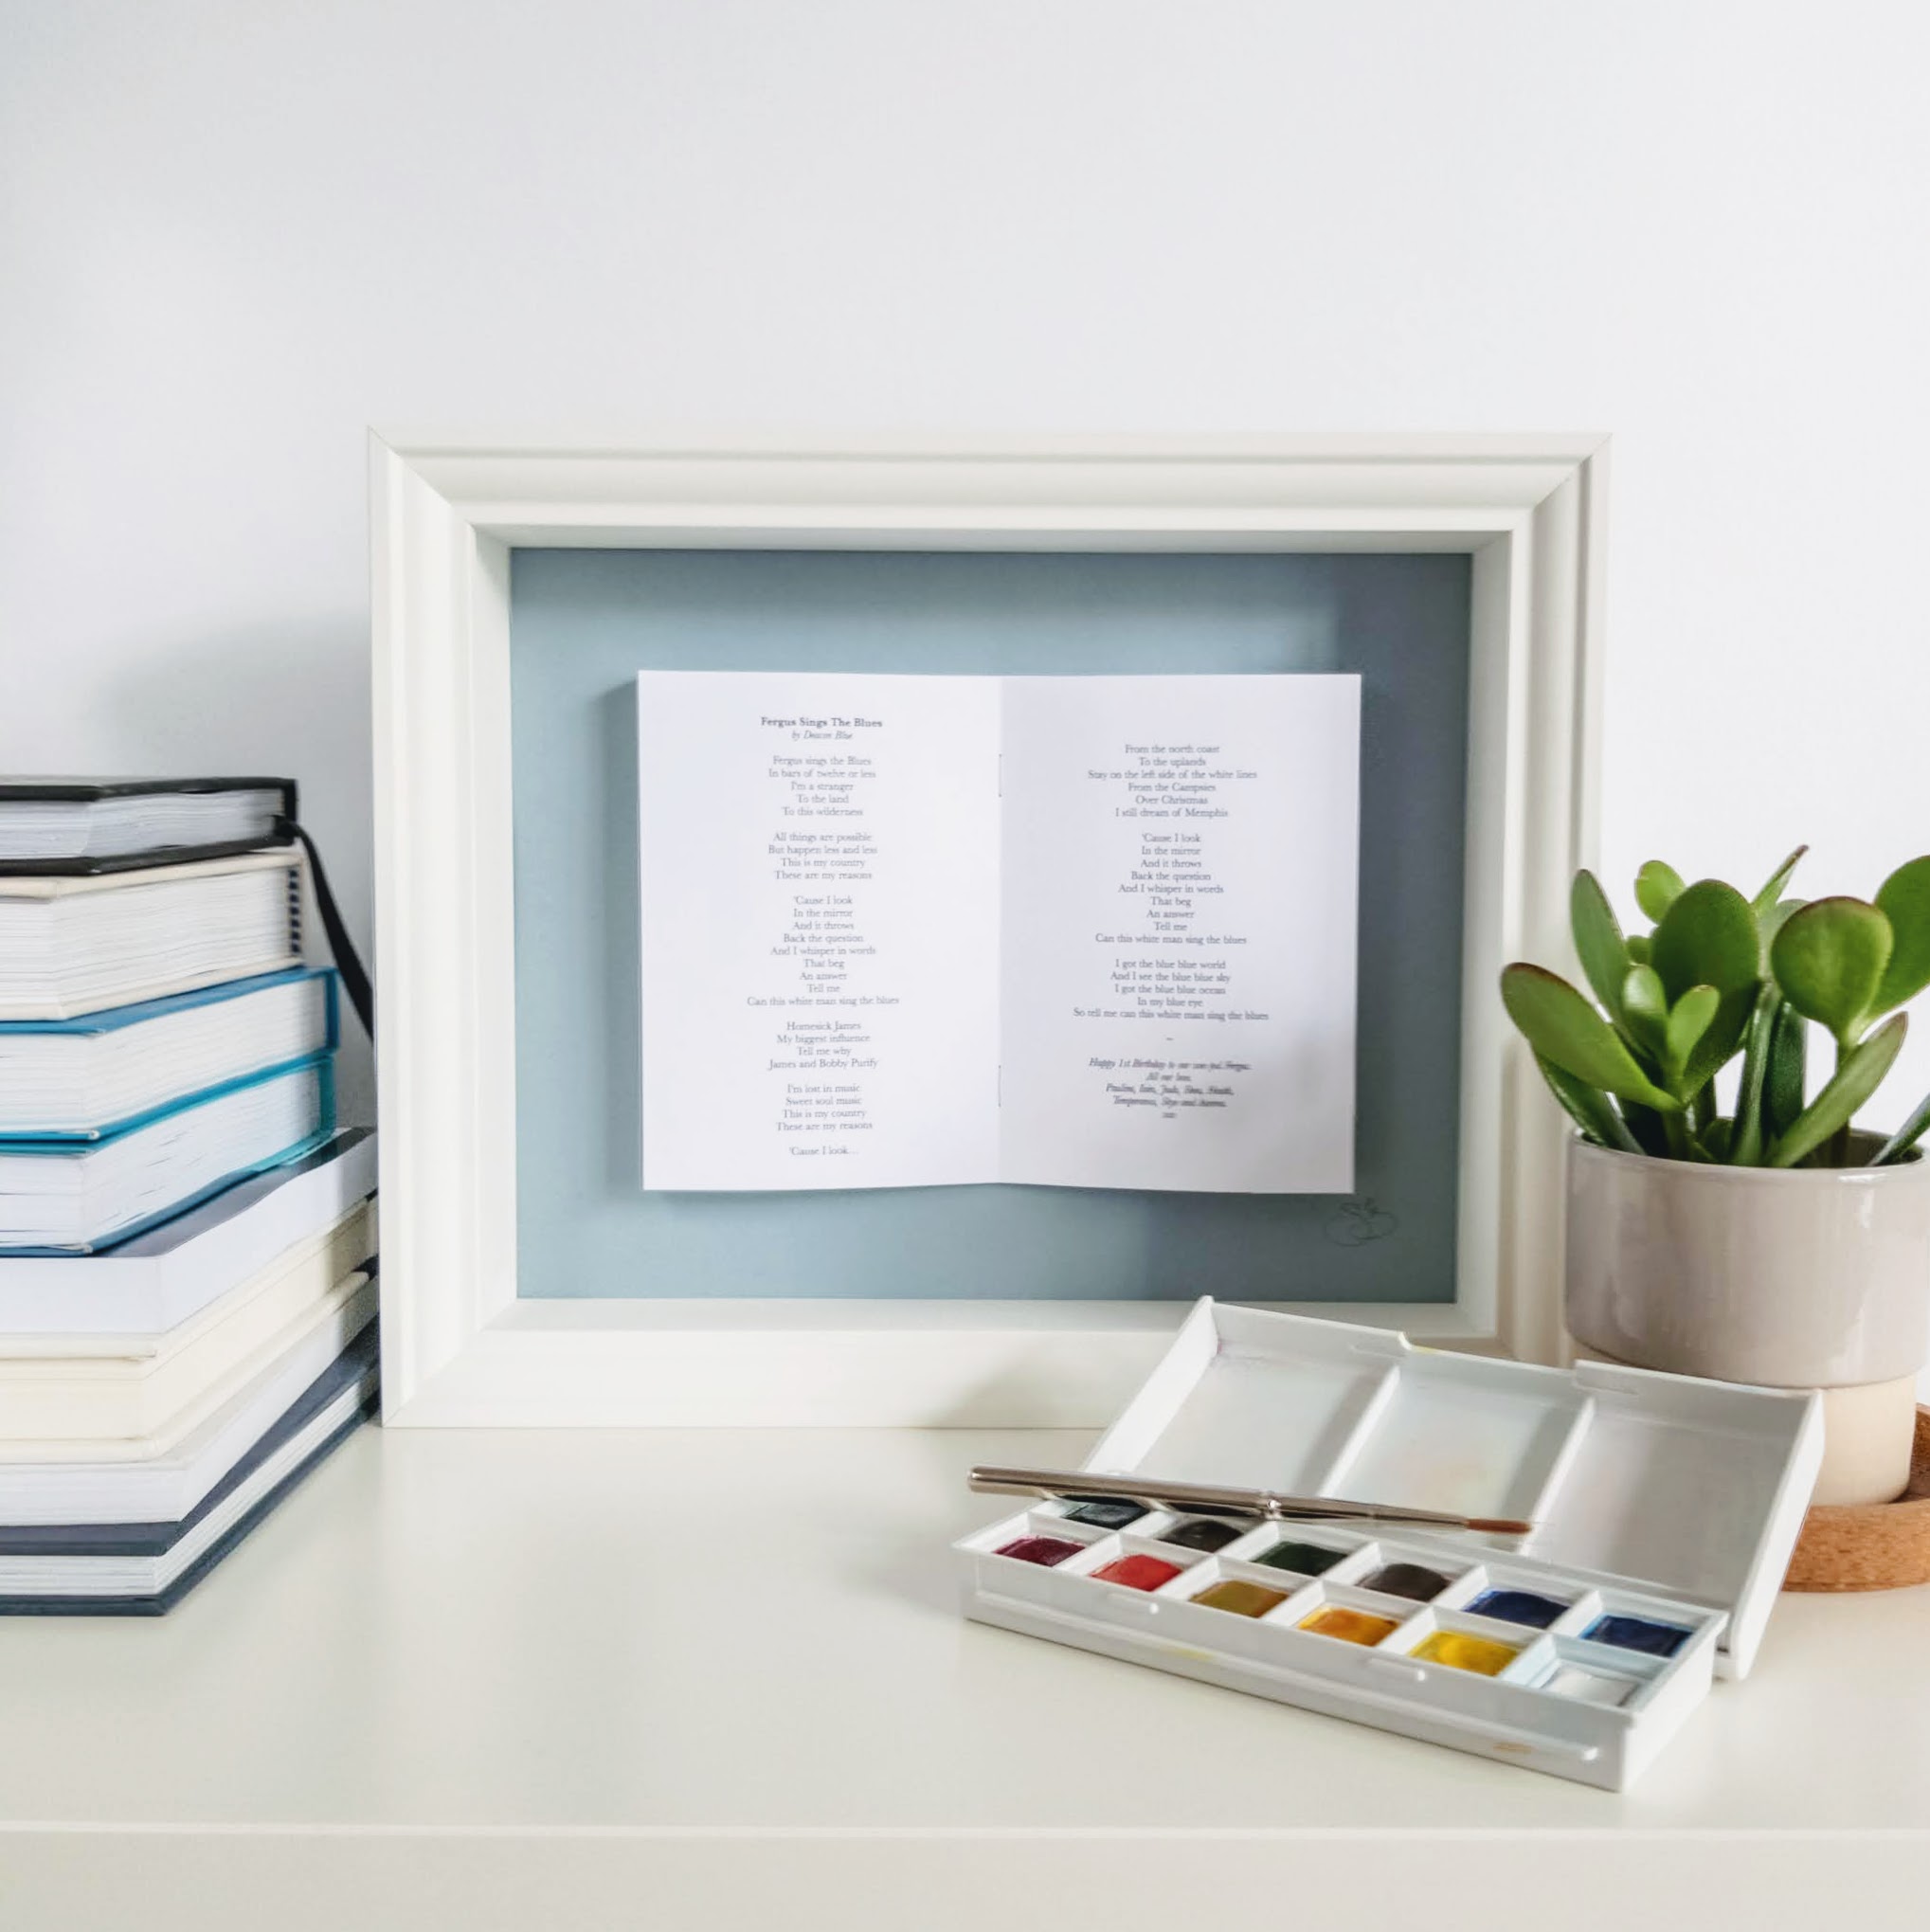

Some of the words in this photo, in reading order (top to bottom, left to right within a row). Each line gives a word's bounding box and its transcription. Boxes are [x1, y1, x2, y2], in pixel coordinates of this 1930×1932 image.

[761, 716, 797, 729] Fergus
[799, 716, 828, 730] Sings
[830, 717, 851, 727] The
[854, 717, 883, 728] Blues
[834, 730, 854, 740] Blue
[1125, 744, 1149, 754] From
[1151, 744, 1166, 754] the
[1168, 744, 1195, 753] north
[773, 755, 803, 767] Fergus
[804, 755, 828, 767] sings
[830, 755, 845, 766] the
[847, 755, 872, 766] Blues
[1138, 756, 1151, 767] To
[1152, 756, 1168, 767] the
[1169, 756, 1207, 769] uplands
[1088, 769, 1109, 781] Stay
[1124, 769, 1140, 780] the
[1141, 769, 1157, 779] left
[1158, 769, 1176, 779] side
[1178, 769, 1189, 779] of
[1191, 769, 1206, 779] the
[1236, 769, 1257, 779] lines
[817, 783, 854, 793] stranger
[1127, 782, 1153, 792] From
[1154, 783, 1169, 792] the
[1171, 782, 1217, 795] Campsies
[795, 793, 809, 803] To
[811, 793, 827, 804] the
[828, 793, 850, 803] land
[1135, 794, 1160, 804] Over
[1161, 794, 1209, 804] Christmas
[781, 806, 795, 816] To
[797, 806, 814, 816] this
[1122, 807, 1138, 818] still
[1139, 807, 1170, 818] dream
[1171, 807, 1182, 818] of
[1184, 807, 1229, 820] Memphis
[773, 832, 787, 841] All
[788, 832, 818, 844] things
[836, 832, 872, 844] possible
[1181, 833, 1201, 843] look
[768, 844, 785, 855] But
[786, 844, 822, 858] happen
[823, 844, 840, 855] less
[841, 844, 860, 855] and
[861, 844, 878, 855] less
[780, 857, 802, 867] This
[803, 858, 812, 867] is
[813, 859, 828, 869] my
[829, 858, 866, 869] country
[1140, 858, 1161, 868] And
[1162, 858, 1169, 868] it
[1171, 858, 1202, 868] throws
[774, 870, 803, 879] These
[821, 873, 836, 882] my
[1130, 871, 1154, 880] Back
[1155, 871, 1170, 881] the
[1172, 871, 1212, 883] question
[833, 894, 853, 905] look
[1149, 895, 1173, 906] That
[1175, 896, 1192, 909] beg
[793, 908, 803, 918] In
[805, 908, 821, 918] the
[822, 908, 854, 918] mirror
[1146, 909, 1161, 918] An
[1163, 911, 1196, 919] answer
[792, 920, 813, 930] And
[814, 920, 821, 930] it
[823, 920, 855, 930] throws
[1153, 921, 1171, 931] Tell
[784, 932, 806, 943] Back
[807, 933, 823, 943] the
[824, 935, 864, 945] question
[770, 946, 791, 956] And
[799, 946, 836, 958] whisper
[837, 946, 847, 955] in
[848, 946, 876, 955] words
[803, 958, 826, 968] That
[827, 958, 845, 970] beg
[1122, 961, 1137, 971] got
[1139, 959, 1154, 968] the
[1155, 959, 1176, 969] blue
[1177, 959, 1198, 969] blue
[1199, 960, 1226, 969] world
[799, 971, 814, 981] An
[806, 983, 824, 994] Tell
[747, 996, 767, 1006] Can
[769, 996, 786, 1006] this
[839, 996, 858, 1007] sing
[858, 996, 875, 1005] the
[875, 995, 899, 1004] blues
[1137, 996, 1147, 1006] In
[1148, 999, 1164, 1009] my
[1165, 996, 1186, 1007] blue
[1187, 1000, 1203, 1009] eye
[786, 1021, 833, 1031] Homesick
[833, 1020, 862, 1033] James
[777, 1034, 793, 1045] My
[795, 1034, 827, 1046] biggest
[829, 1033, 871, 1043] influence
[796, 1046, 814, 1056] Tell
[832, 1046, 852, 1057] why
[767, 1058, 797, 1072] James
[799, 1058, 817, 1069] and
[819, 1058, 849, 1070] Bobby
[851, 1058, 878, 1070] Purify
[804, 1084, 821, 1093] lost
[822, 1084, 833, 1093] in
[834, 1083, 860, 1093] music
[785, 1096, 813, 1107] Sweet
[815, 1095, 834, 1106] soul
[835, 1095, 862, 1106] music
[782, 1109, 803, 1119] This
[804, 1109, 812, 1118] is
[814, 1110, 829, 1120] my
[830, 1110, 867, 1120] country
[776, 1122, 804, 1131] These
[822, 1123, 837, 1132] my
